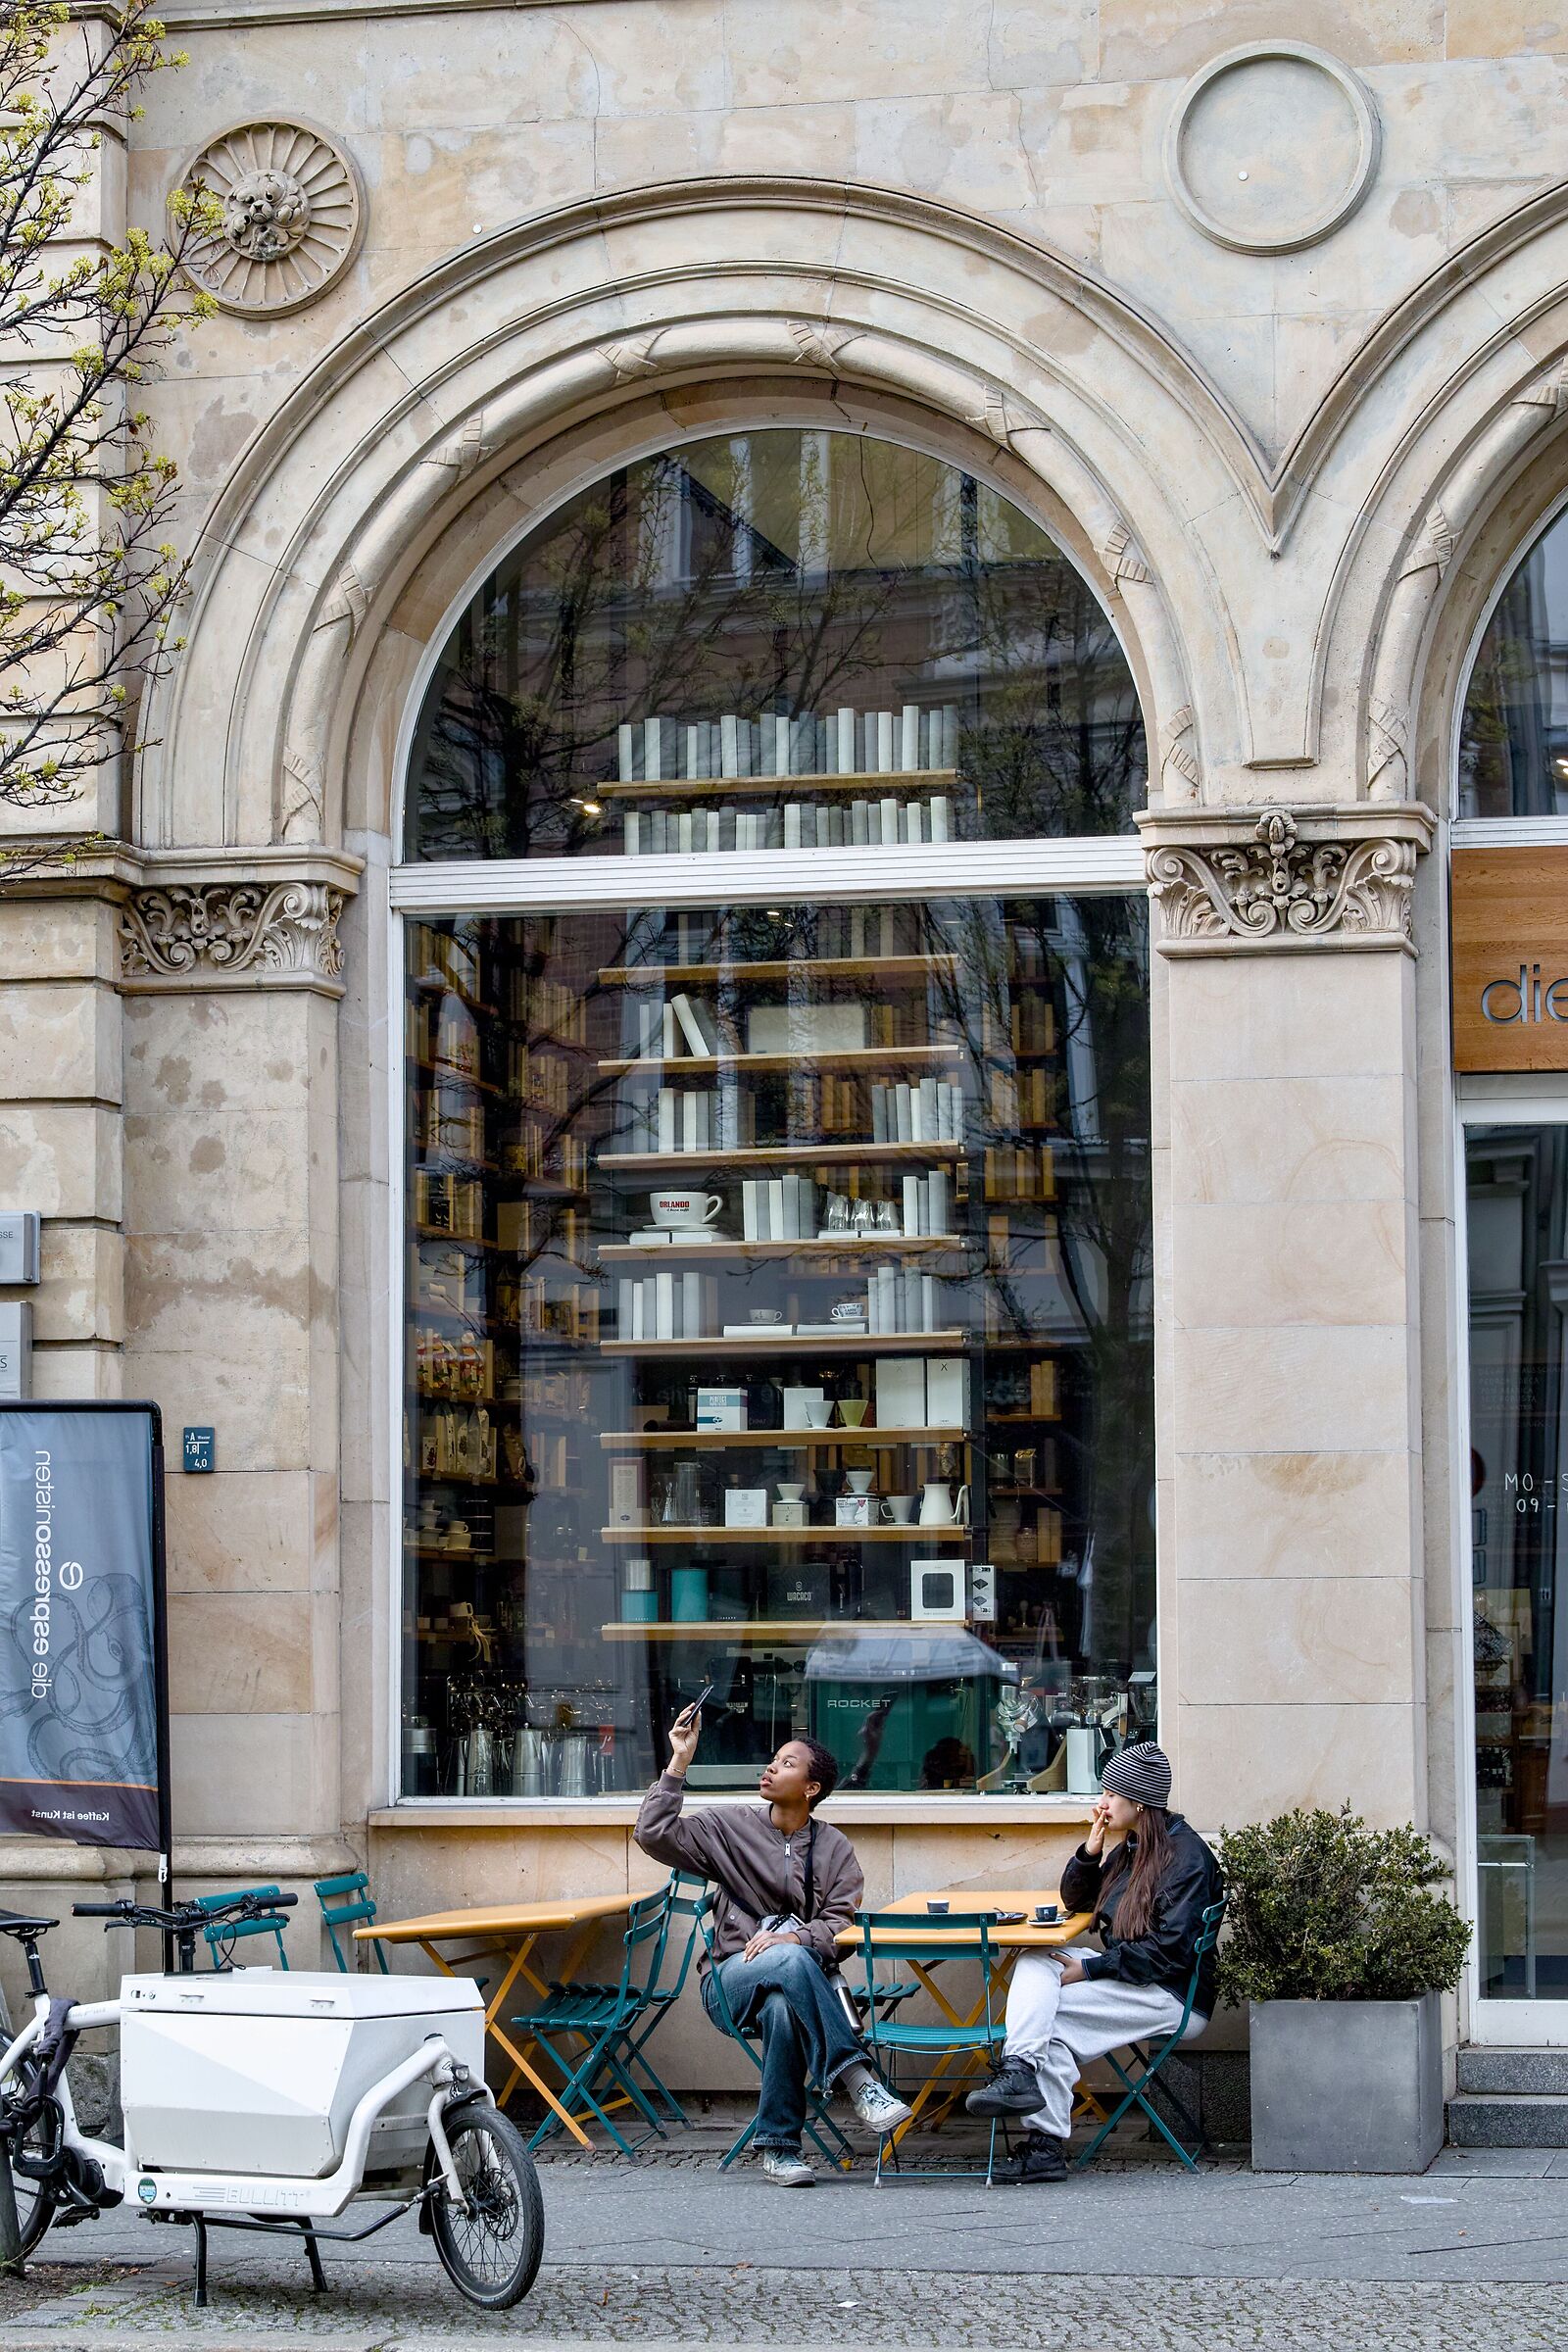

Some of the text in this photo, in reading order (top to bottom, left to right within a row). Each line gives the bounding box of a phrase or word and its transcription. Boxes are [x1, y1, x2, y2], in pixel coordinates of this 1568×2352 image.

[194, 1458, 208, 1469] 4,0
[1504, 1473, 1534, 1492] MO
[1516, 1497, 1540, 1513] 09
[787, 1592, 812, 1601] WACACO
[827, 1699, 891, 1708] ROCKET
